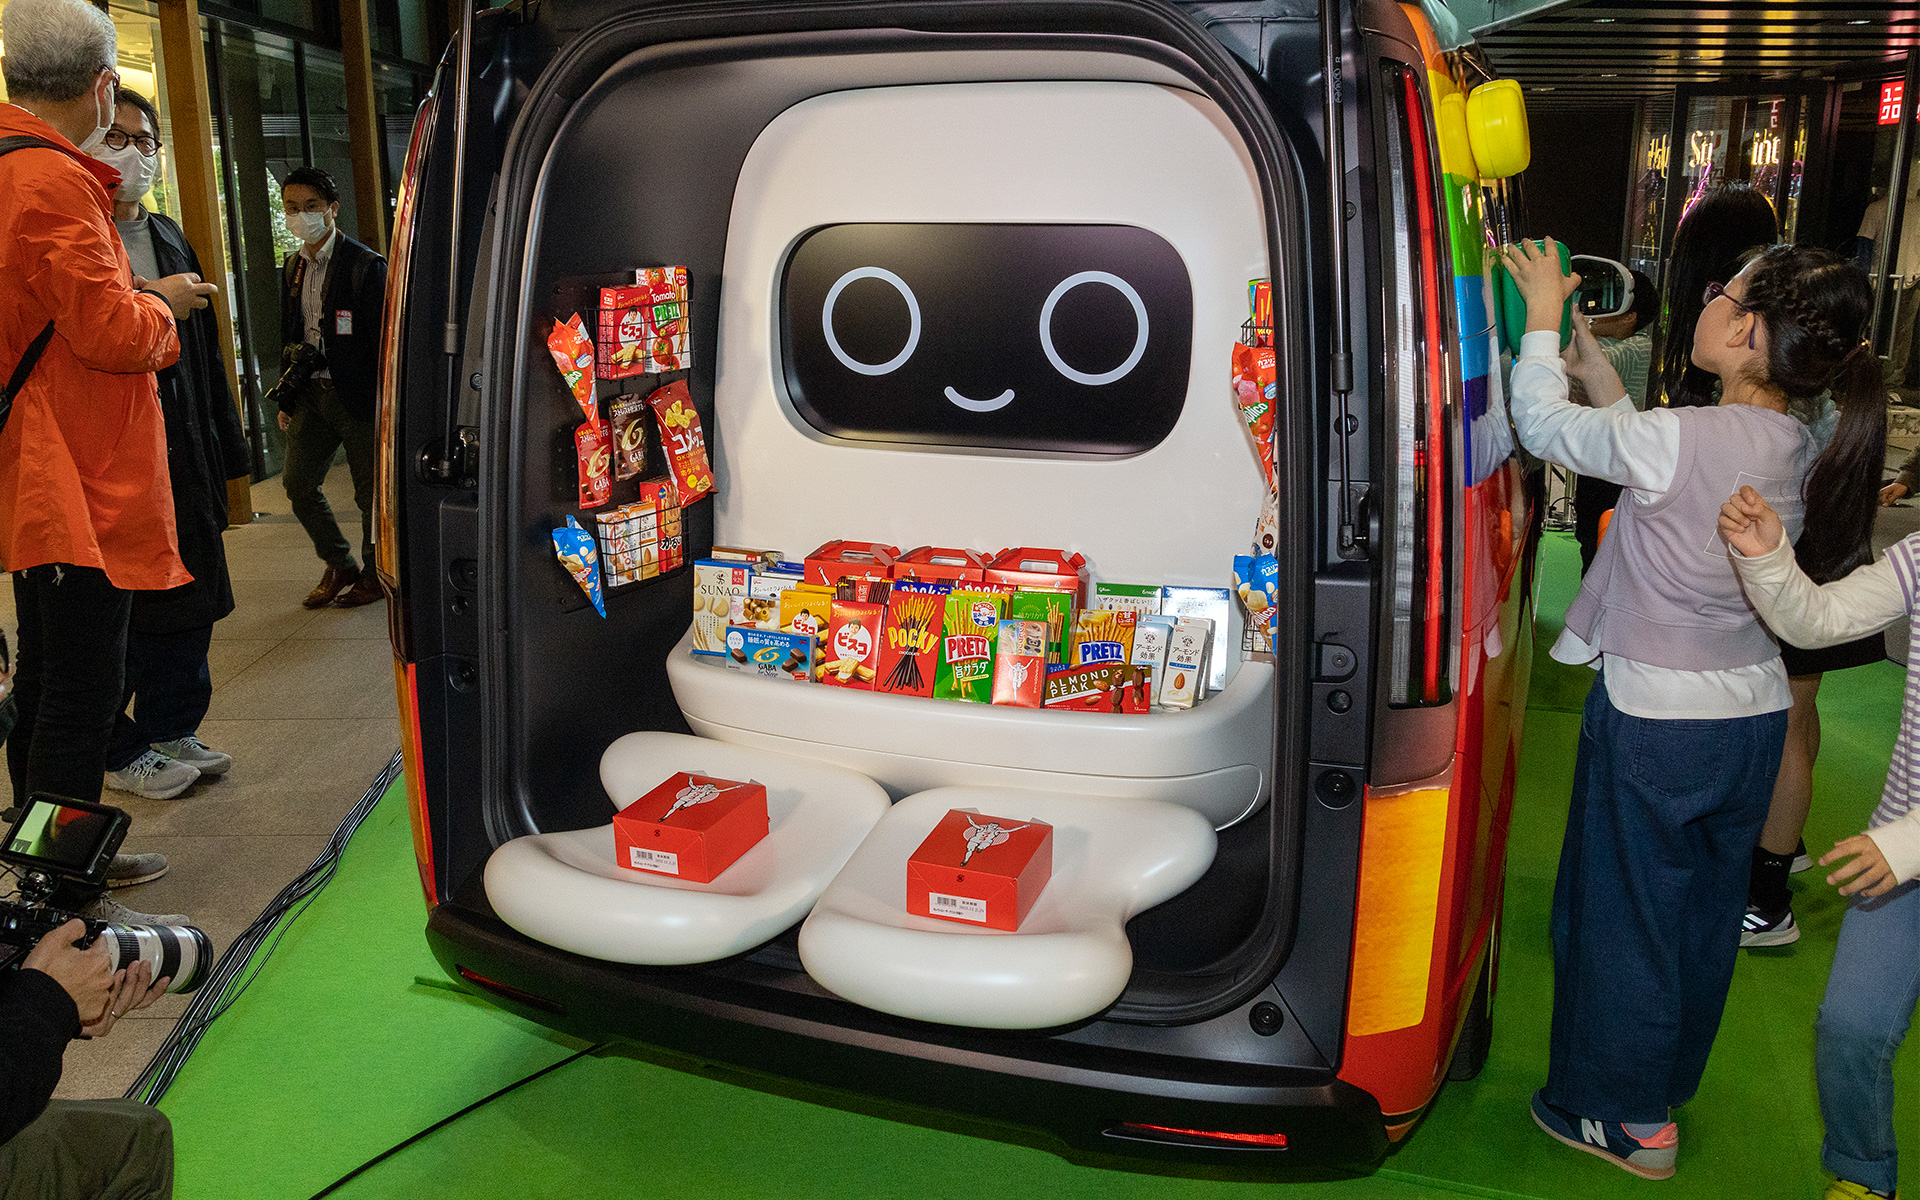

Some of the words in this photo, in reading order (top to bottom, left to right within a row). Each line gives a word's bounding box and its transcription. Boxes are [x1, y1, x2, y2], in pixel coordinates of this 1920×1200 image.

[651, 290, 676, 304] Tomato
[621, 322, 642, 340] ビスコ
[594, 477, 609, 491] GABA
[700, 584, 740, 597] SUNAO
[794, 619, 816, 635] ビスコ
[837, 632, 868, 656] ビスコ
[947, 637, 988, 659] PRETZ
[1135, 643, 1163, 653] アーモンド
[1082, 644, 1122, 662] PRETZ
[1140, 652, 1156, 661] 効果
[1172, 647, 1200, 657] アーモンド
[1175, 656, 1193, 664] 効果
[758, 663, 776, 672] GABA
[955, 661, 989, 679] 旨サラダ
[1049, 671, 1110, 691] ALMOND
[1050, 684, 1090, 698] PEAK
[1581, 1118, 1608, 1148] N
